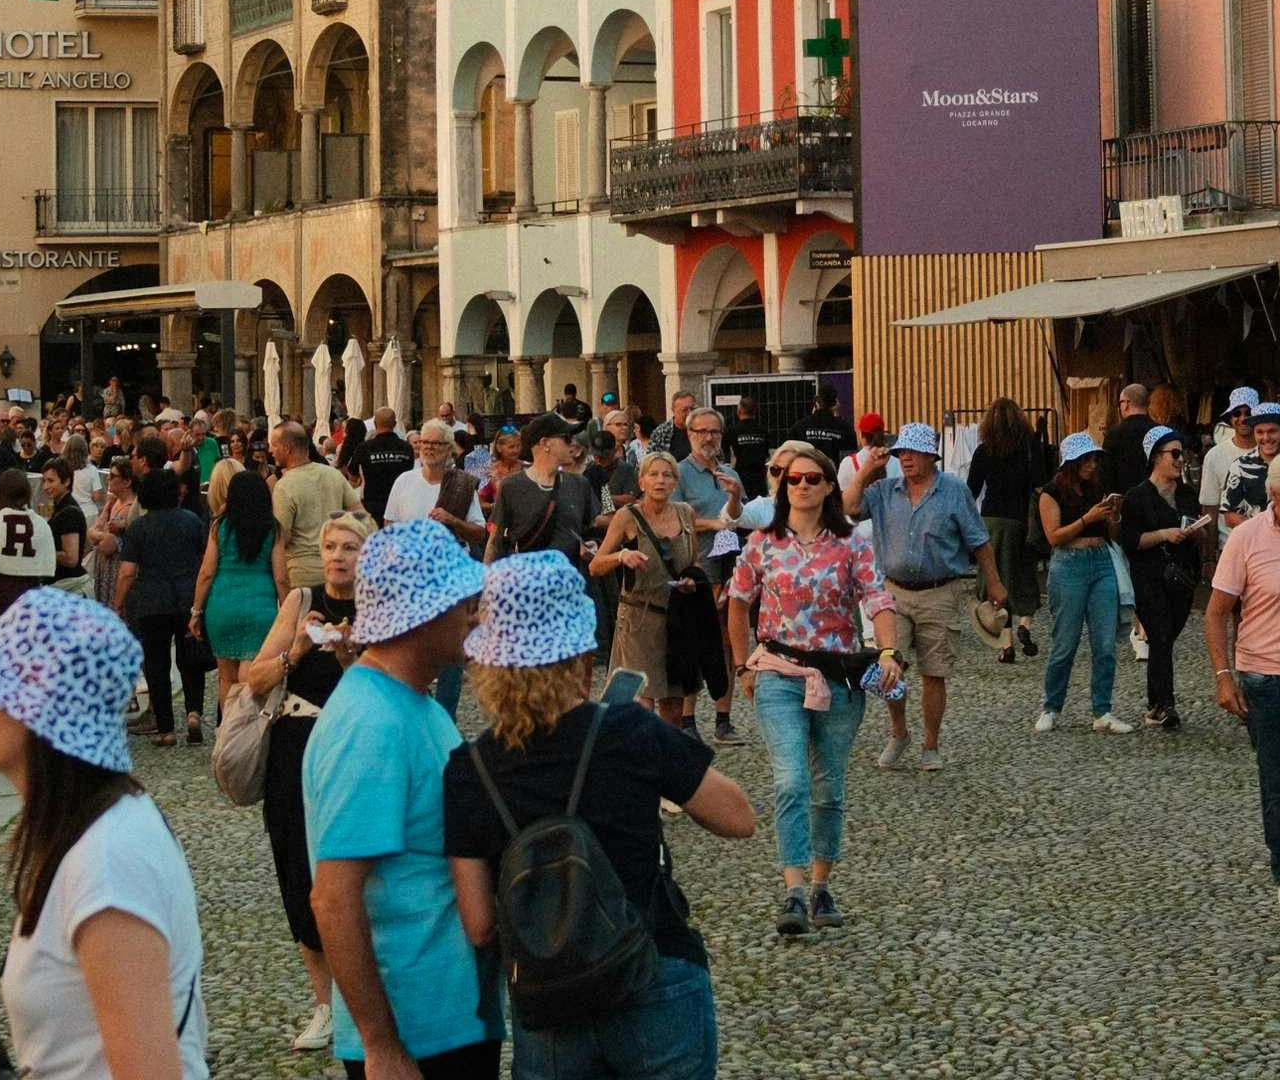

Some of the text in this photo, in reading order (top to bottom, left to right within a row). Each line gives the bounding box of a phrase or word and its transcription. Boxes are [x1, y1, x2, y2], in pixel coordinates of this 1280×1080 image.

[40, 71, 132, 90] ANGELO
[921, 88, 1039, 107] Moon&Stars
[949, 110, 1010, 119] PIAZZA GRANDE
[1, 514, 36, 557] R
